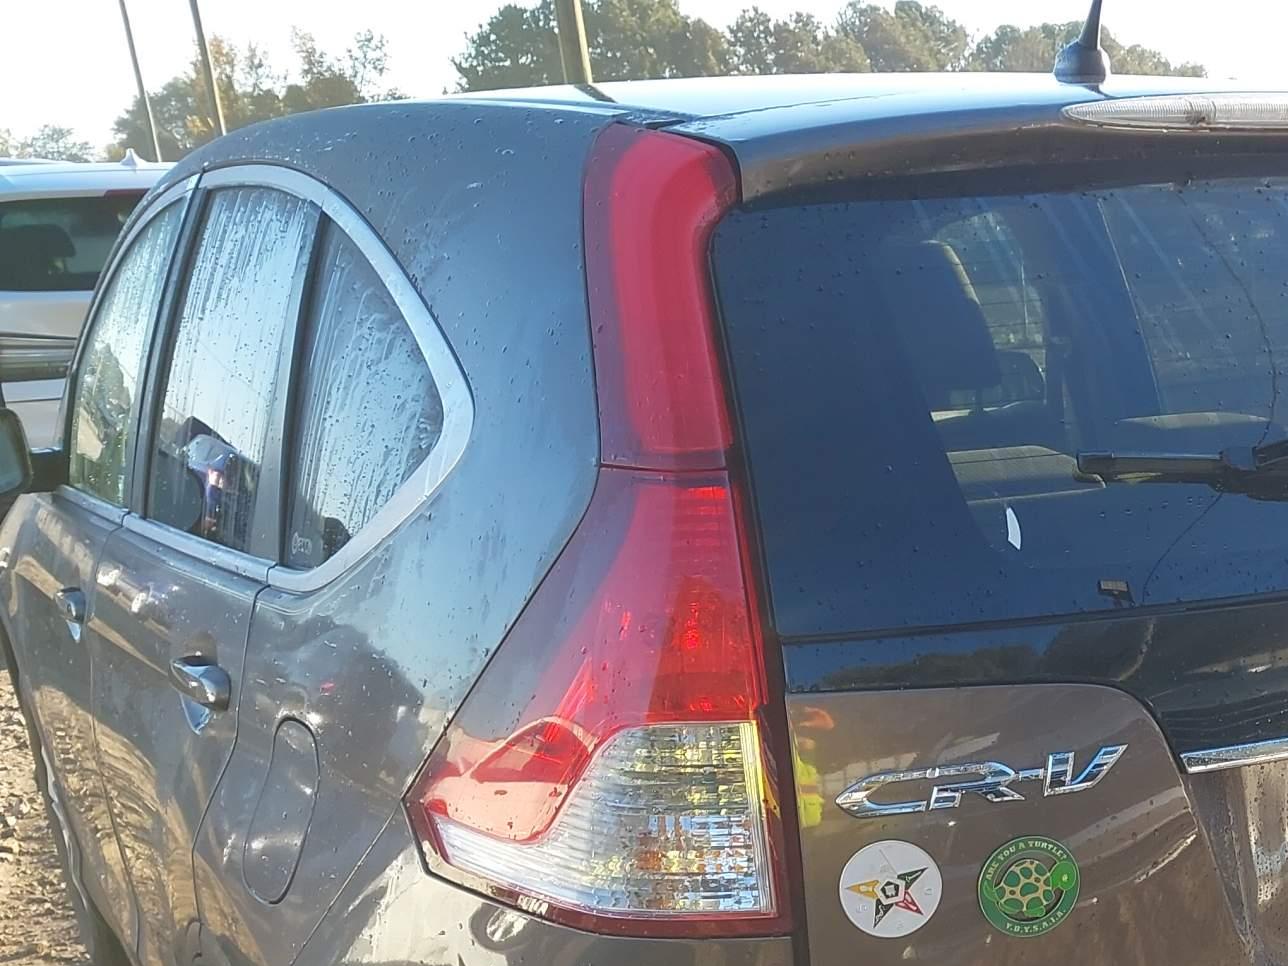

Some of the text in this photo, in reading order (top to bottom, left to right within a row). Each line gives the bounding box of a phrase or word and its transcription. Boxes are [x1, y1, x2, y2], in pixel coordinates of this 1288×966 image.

[835, 744, 1129, 818] CR-V
[985, 841, 1067, 880] ARE YOU A TURTLE?
